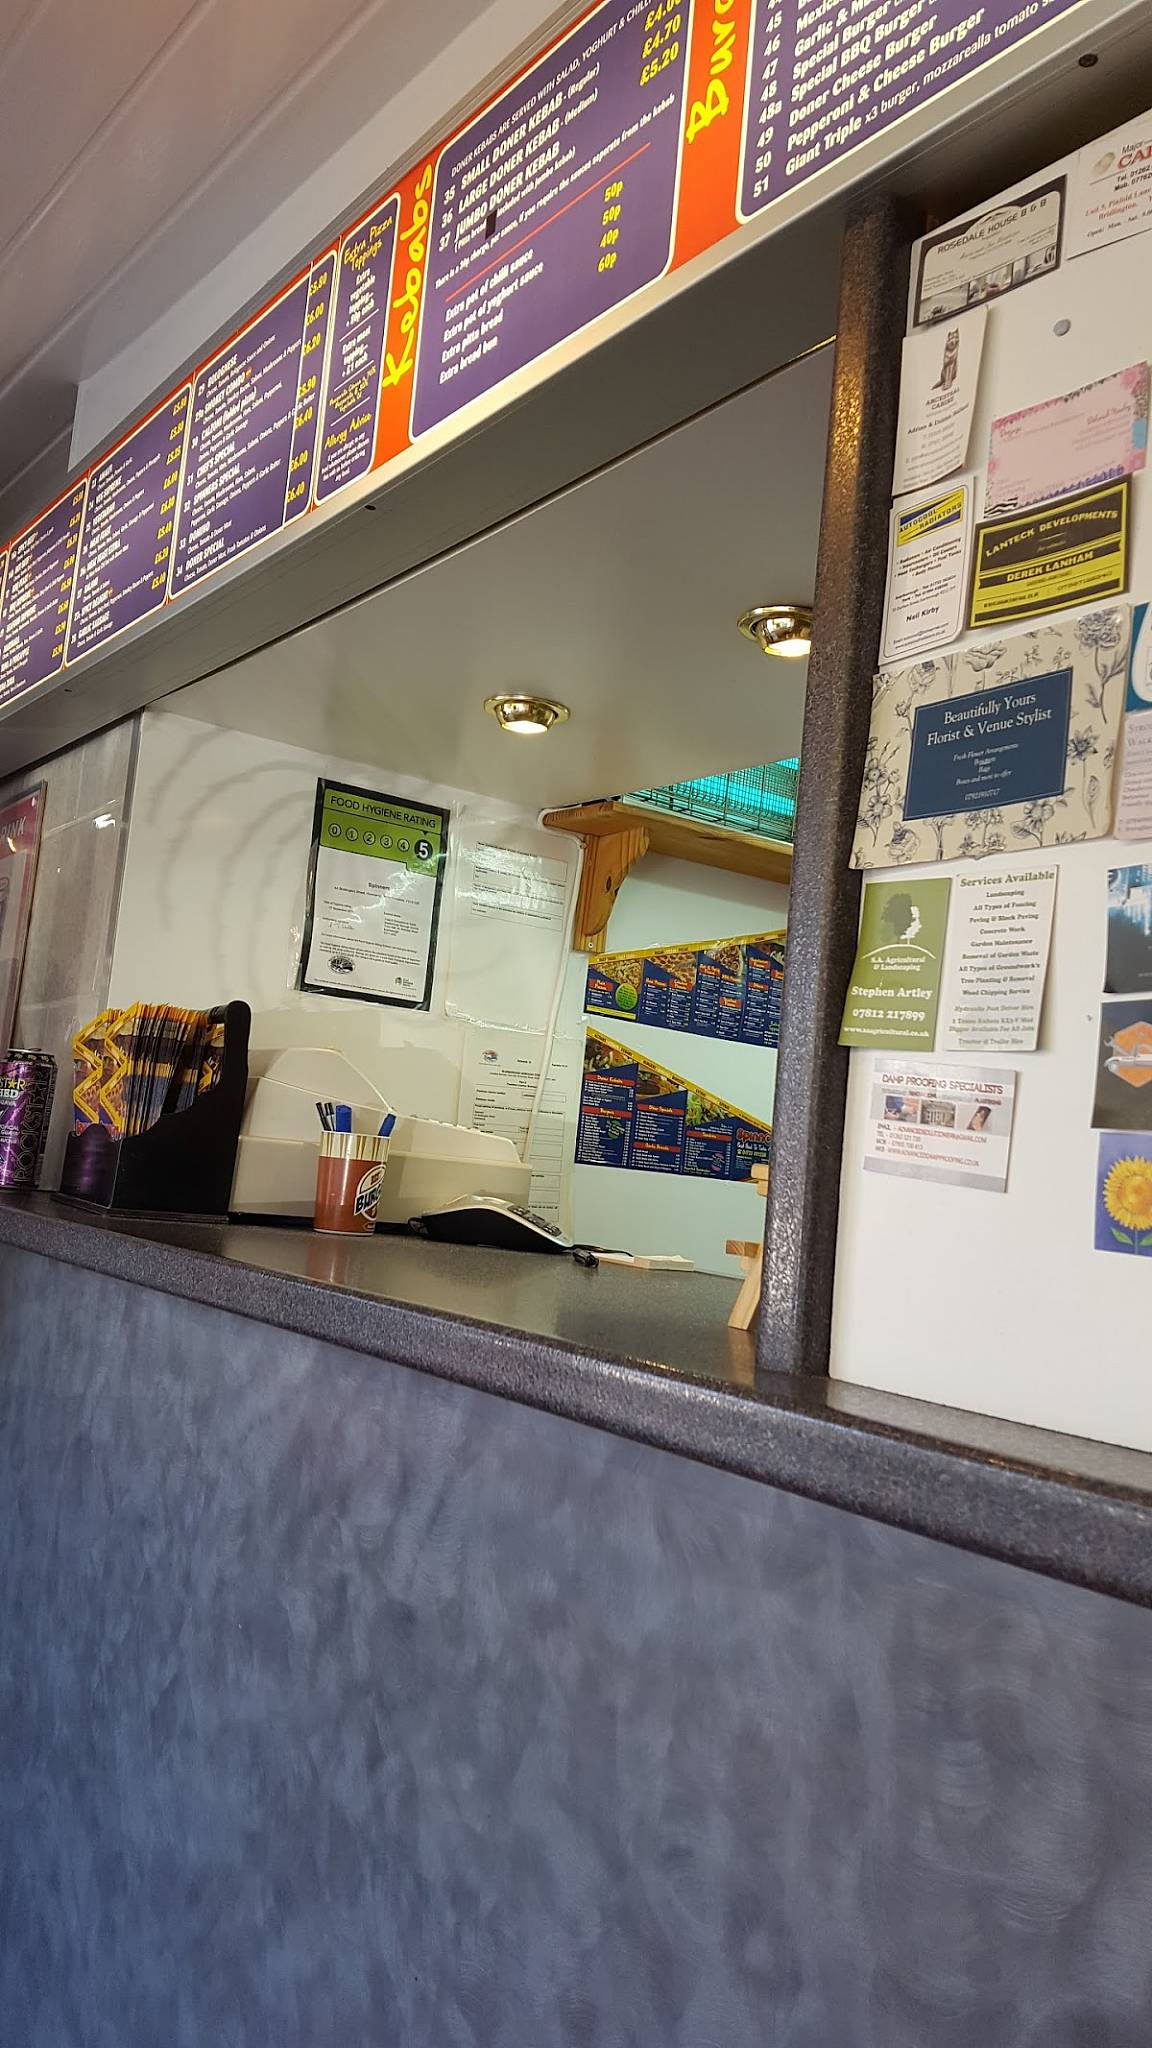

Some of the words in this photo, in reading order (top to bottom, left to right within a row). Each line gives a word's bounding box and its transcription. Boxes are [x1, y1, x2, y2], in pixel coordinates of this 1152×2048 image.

[766, 10, 782, 33] 45
[760, 80, 777, 102] 48
[792, 33, 839, 80] Special
[842, 1, 891, 45] Burger
[761, 58, 779, 80] 47
[794, 20, 833, 57] Garlic
[836, 7, 849, 27] &
[764, 34, 781, 57] 46
[758, 100, 783, 124] 48a
[790, 56, 837, 102] Special
[840, 34, 872, 68] BBQ
[874, 0, 924, 44] Burger
[452, 150, 473, 177] DONER
[473, 131, 498, 158] KEBABS
[498, 118, 511, 137] ARE
[511, 96, 537, 124] SERVED
[538, 79, 555, 101] WITH
[556, 58, 580, 85] SALAD,
[582, 23, 618, 60] YOGHURT
[619, 17, 626, 30] &
[755, 151, 771, 173] 50
[787, 93, 854, 152] Pepperoni
[857, 84, 870, 104] &
[873, 49, 925, 92] Cheese
[928, 7, 985, 56] Burger
[756, 126, 774, 148] 49
[788, 88, 829, 127] Doner
[832, 54, 882, 96] Cheese
[884, 14, 938, 60] Burger
[753, 175, 769, 198] 51
[785, 143, 820, 177] Giant
[823, 117, 862, 151] Triple
[864, 105, 878, 125] x3
[880, 80, 920, 113] burger,
[922, 33, 991, 86] mozzarealla
[994, 2, 1039, 39] tomato
[442, 208, 454, 228] 36
[459, 178, 488, 214] LARGE
[489, 149, 524, 188] DONER
[525, 117, 560, 158] KEBAB
[564, 87, 598, 125] (Medium)
[642, 14, 681, 59] £4.70
[444, 185, 456, 205] 35
[461, 155, 491, 190] SMALL
[492, 123, 527, 163] DONER
[528, 92, 563, 132] KEBAB
[567, 61, 600, 98] (Regular)
[439, 232, 451, 252] 37
[454, 201, 488, 240] JUMBO
[489, 172, 523, 211] DONER
[525, 141, 560, 180] KEBAB
[639, 41, 679, 87] £5.20
[344, 240, 366, 265] Extra
[369, 216, 393, 242] Pizza
[937, 228, 985, 254] ROSEDALE
[987, 212, 1019, 234] HOUSE
[351, 239, 383, 271] Toppings
[446, 300, 465, 322] Extra
[466, 288, 479, 310] pot
[480, 278, 489, 296] of
[510, 248, 534, 274] sauce
[604, 180, 624, 202] 50p
[382, 164, 432, 388] Kebabs
[444, 321, 463, 343] Extra
[464, 309, 477, 331] pot
[477, 300, 487, 317] of
[487, 278, 519, 314] yoghurt
[519, 261, 544, 287] sauce
[602, 204, 621, 226] 50p
[442, 342, 461, 364] Extra
[480, 307, 504, 336] bread
[600, 228, 619, 248] 40p
[440, 363, 459, 385] Extra
[460, 343, 482, 370] bread
[482, 336, 498, 354] bun
[598, 252, 617, 273] 60p
[325, 429, 348, 450] Allergy
[349, 413, 372, 433] Advice
[899, 508, 937, 532] AUTOCOOL
[919, 502, 962, 529] RADIATORS
[985, 528, 1035, 557] LANTECK
[1039, 510, 1119, 532] DEVELOPMENTS
[1006, 566, 1043, 582] DEREK
[1045, 550, 1094, 571] LANHAM
[905, 613, 920, 622] Neil
[921, 606, 940, 617] Kirby
[927, 730, 961, 746] Florist
[963, 724, 975, 738] &
[977, 717, 1014, 735] Venue
[1016, 707, 1052, 727] Stylist
[944, 700, 1001, 725] Beautifully
[1004, 693, 1037, 710] Yours
[330, 795, 360, 810] FOOD
[362, 803, 402, 821] HYGIENE
[403, 813, 436, 829] RATING
[418, 841, 429, 859] 5
[960, 876, 1003, 888] Services
[1005, 870, 1056, 884] Available
[986, 890, 1025, 898] Landscaping
[984, 903, 1003, 911] Types
[994, 938, 1033, 947] Maintenance
[880, 964, 921, 972] Landscaping
[885, 956, 926, 965] Agricultural
[969, 965, 988, 973] Types
[851, 985, 895, 999] Stephen
[896, 986, 934, 1000] Artley
[852, 1008, 884, 1019] 07812
[886, 1010, 926, 1022] 217899
[882, 1073, 905, 1084] DAMP
[905, 1075, 948, 1089] PROOFING
[949, 1081, 1004, 1096] SPECIALISTS
